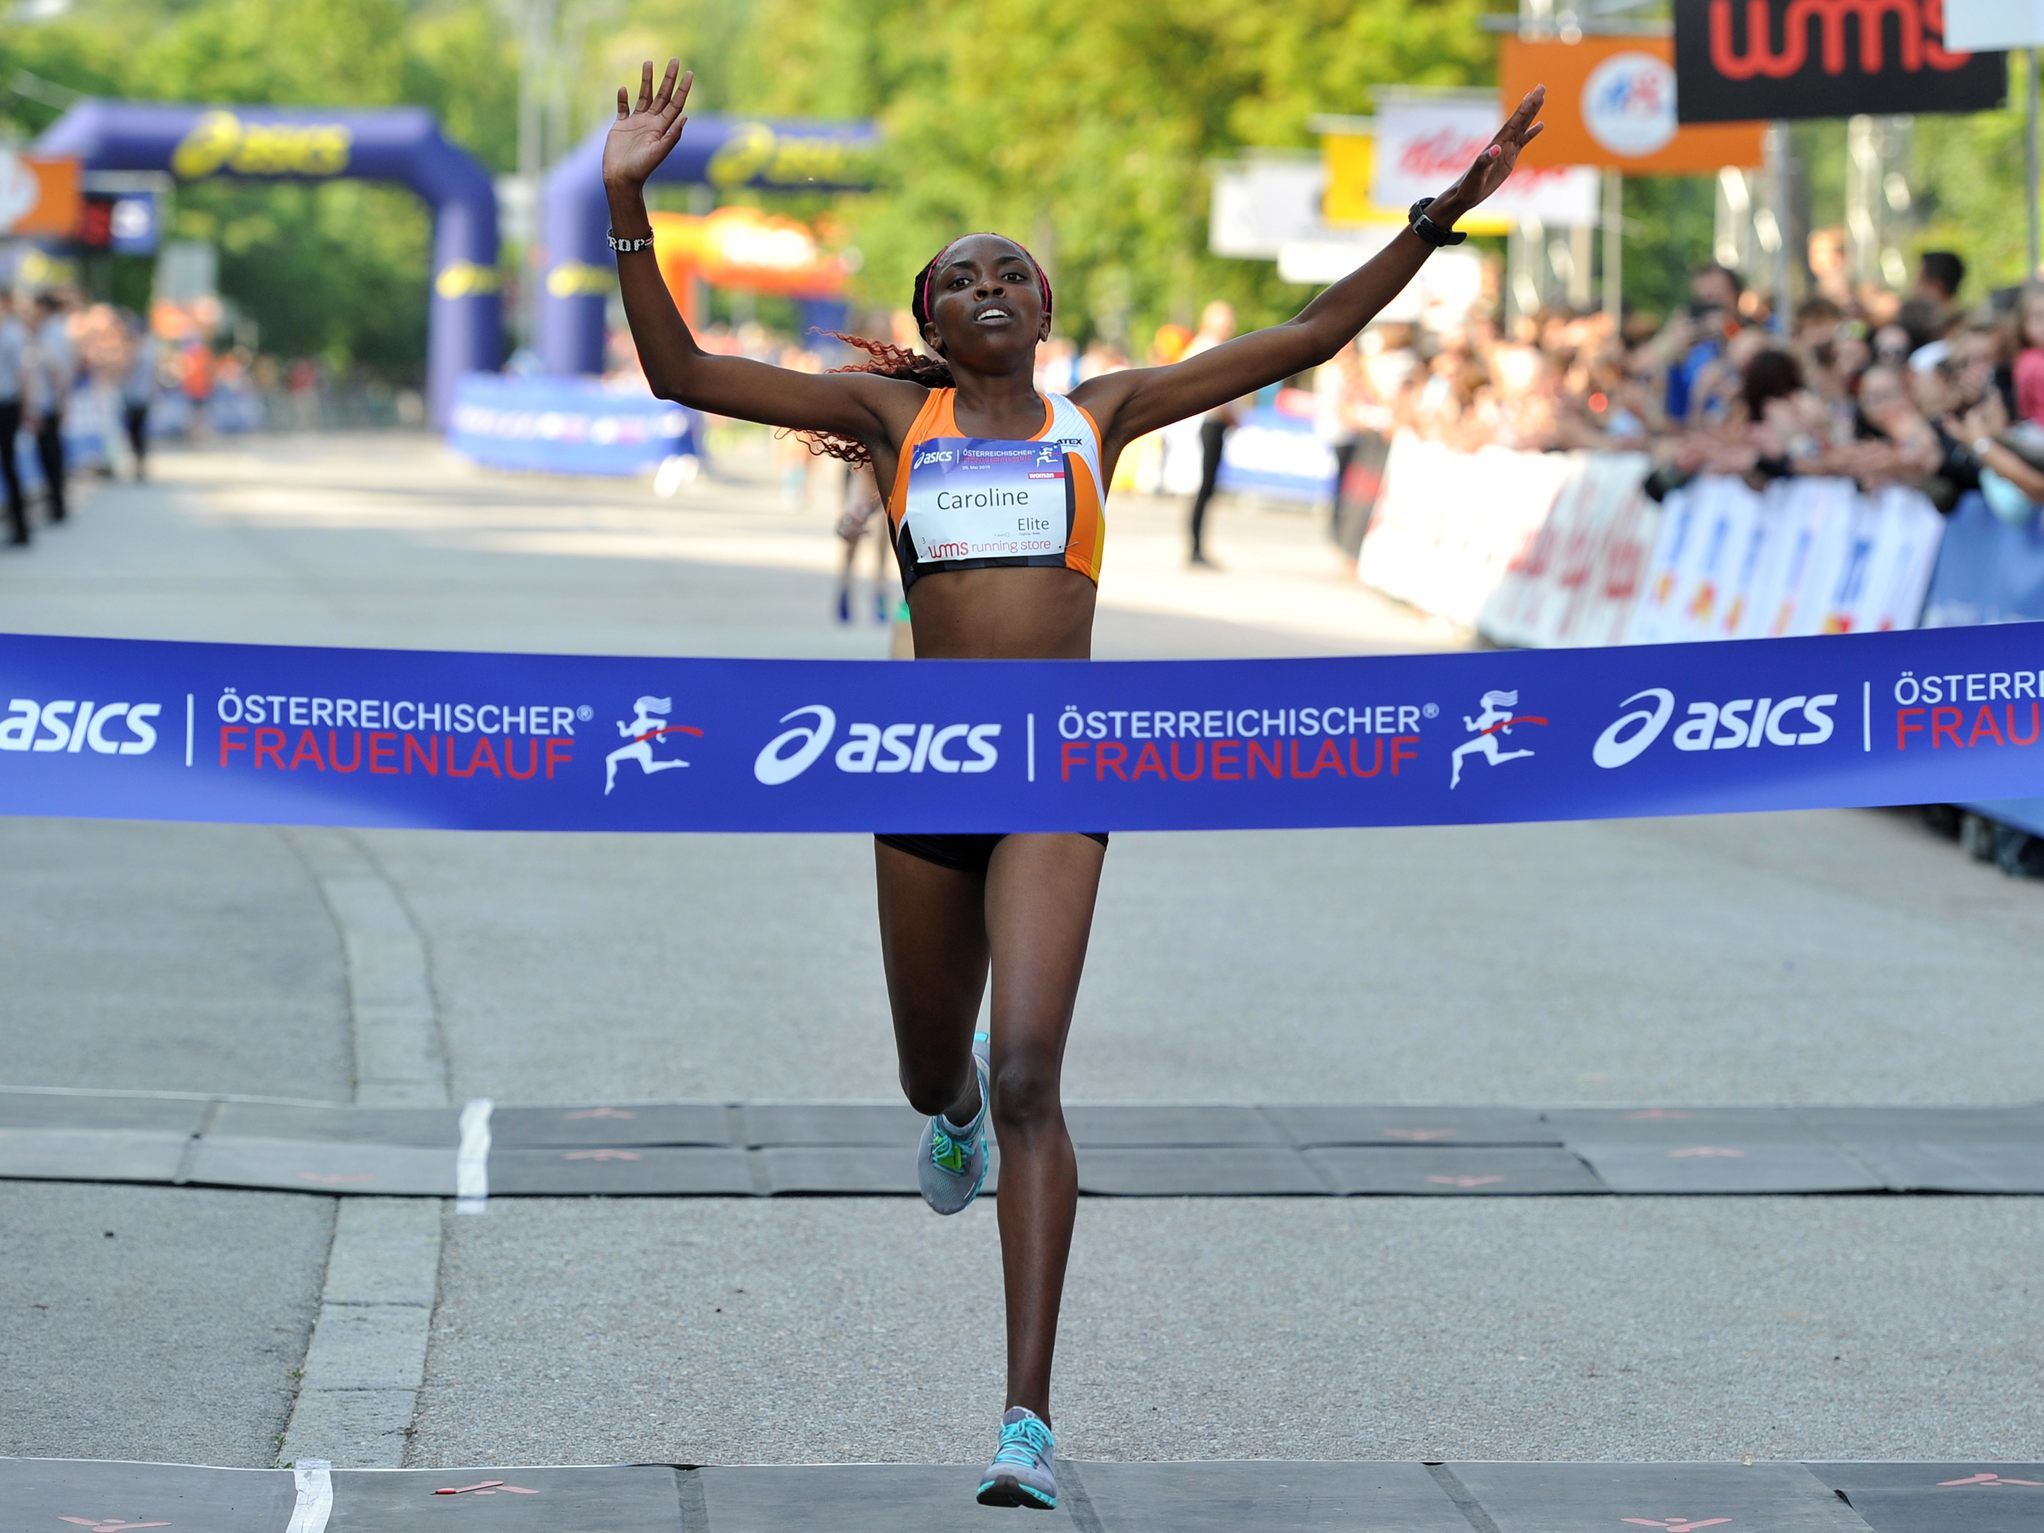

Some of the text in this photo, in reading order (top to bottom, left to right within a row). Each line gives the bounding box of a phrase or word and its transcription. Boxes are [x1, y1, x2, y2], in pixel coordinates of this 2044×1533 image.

[937, 488, 1029, 511] Caroline
[1017, 517, 1049, 531] Elite
[928, 539, 1051, 559] wms running store
[1894, 671, 2044, 705] ÖSTERRE
[1897, 703, 2040, 751] FRAU
[218, 726, 575, 781] FRAUENLAUF
[1060, 736, 1420, 782] FRAUENLAUF
